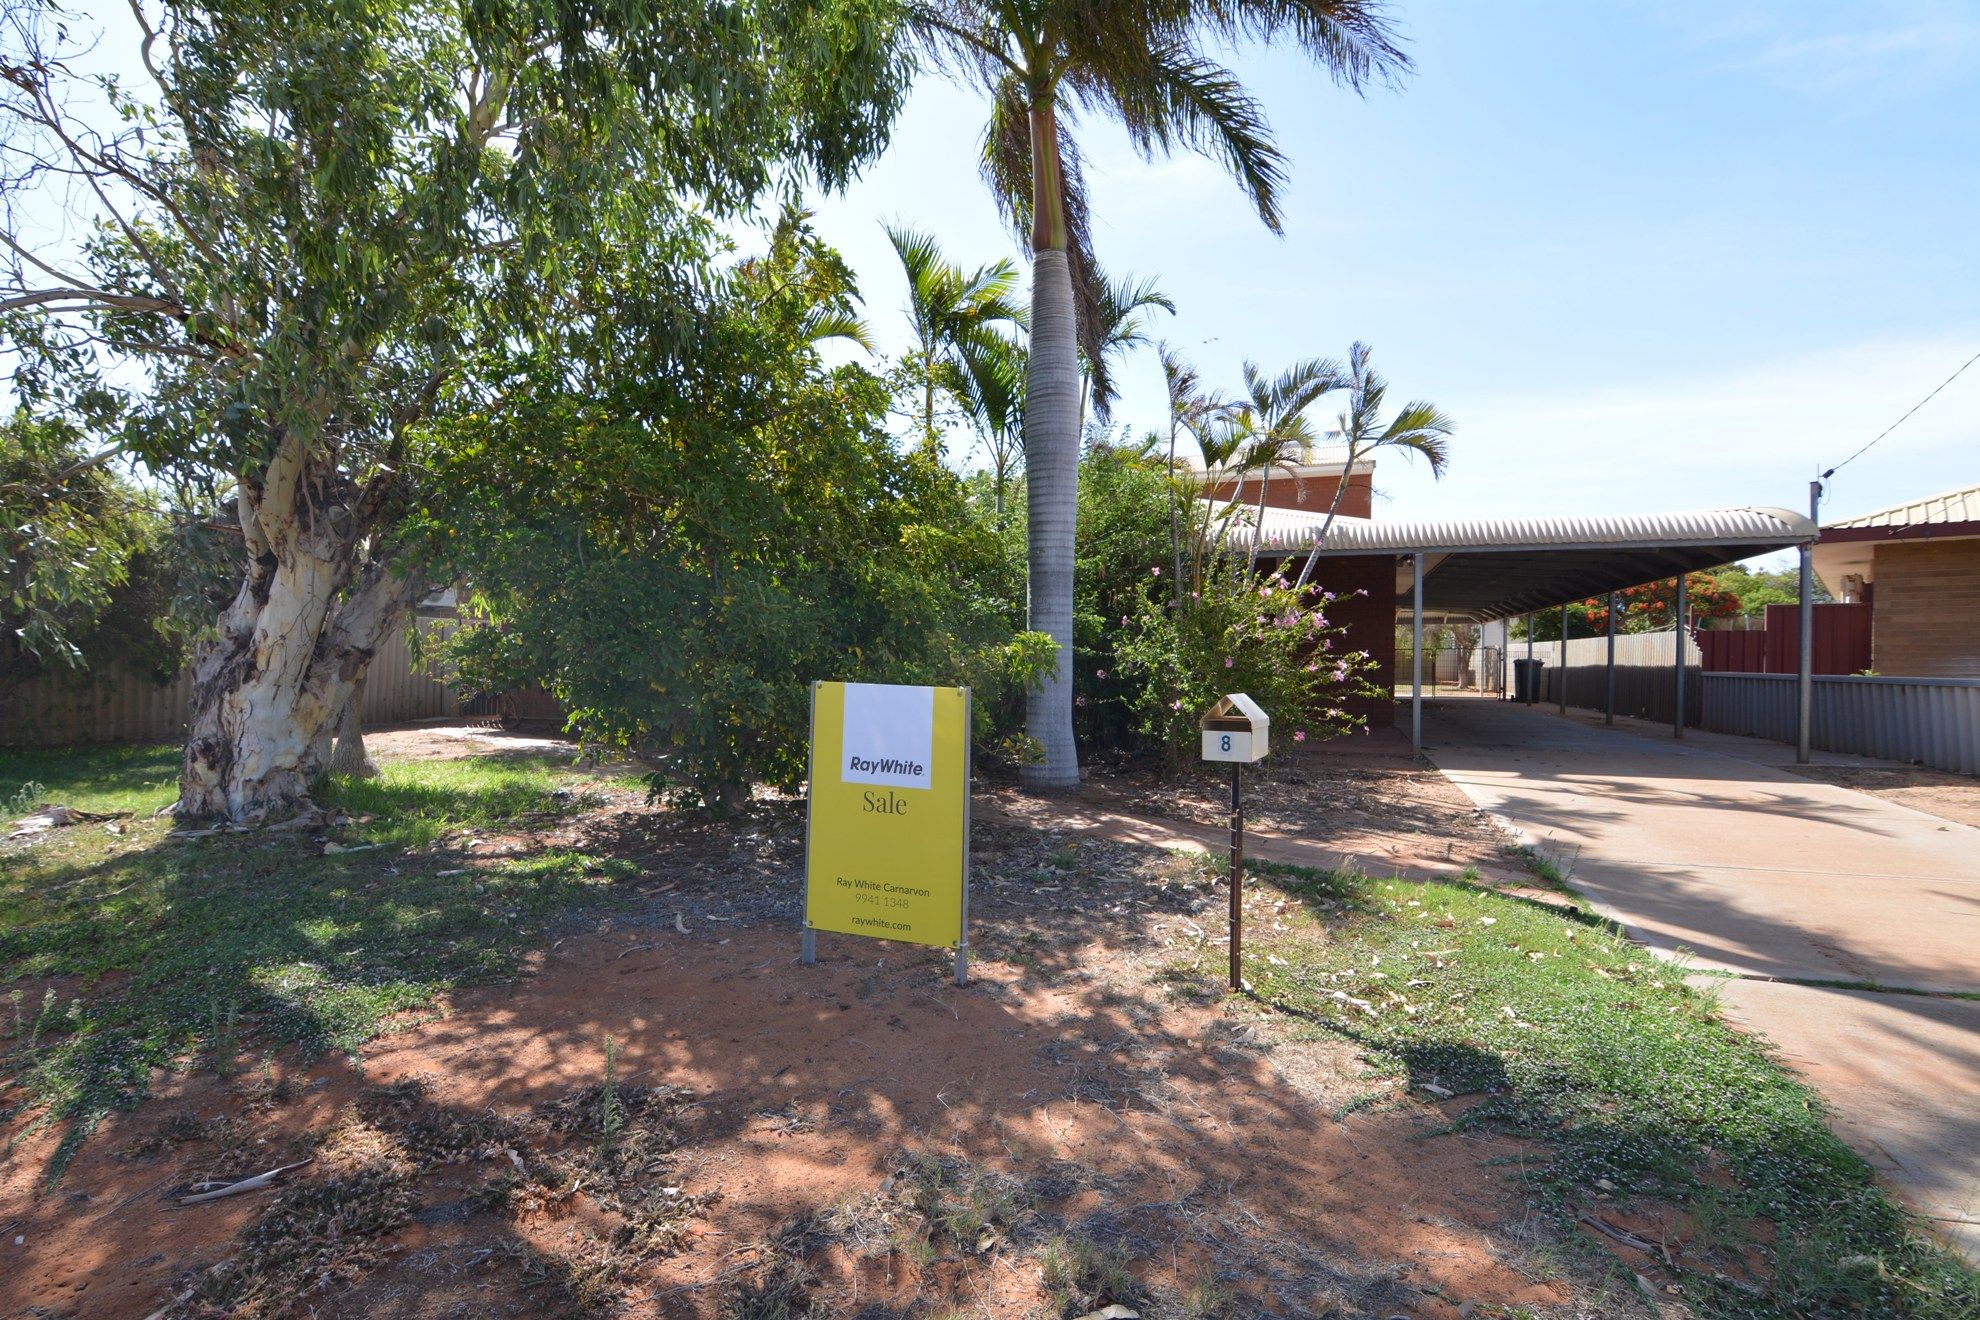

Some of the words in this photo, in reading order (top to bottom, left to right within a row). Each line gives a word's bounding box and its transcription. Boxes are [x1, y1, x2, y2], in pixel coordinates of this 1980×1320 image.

[1221, 735, 1231, 752] 8
[863, 791, 907, 816] Sale
[836, 877, 853, 889] Ray
[854, 879, 881, 891] White
[883, 882, 930, 897] Carnarvon
[855, 893, 880, 906] 9941
[884, 896, 909, 909] 1348
[851, 916, 911, 931] raywhite.com
